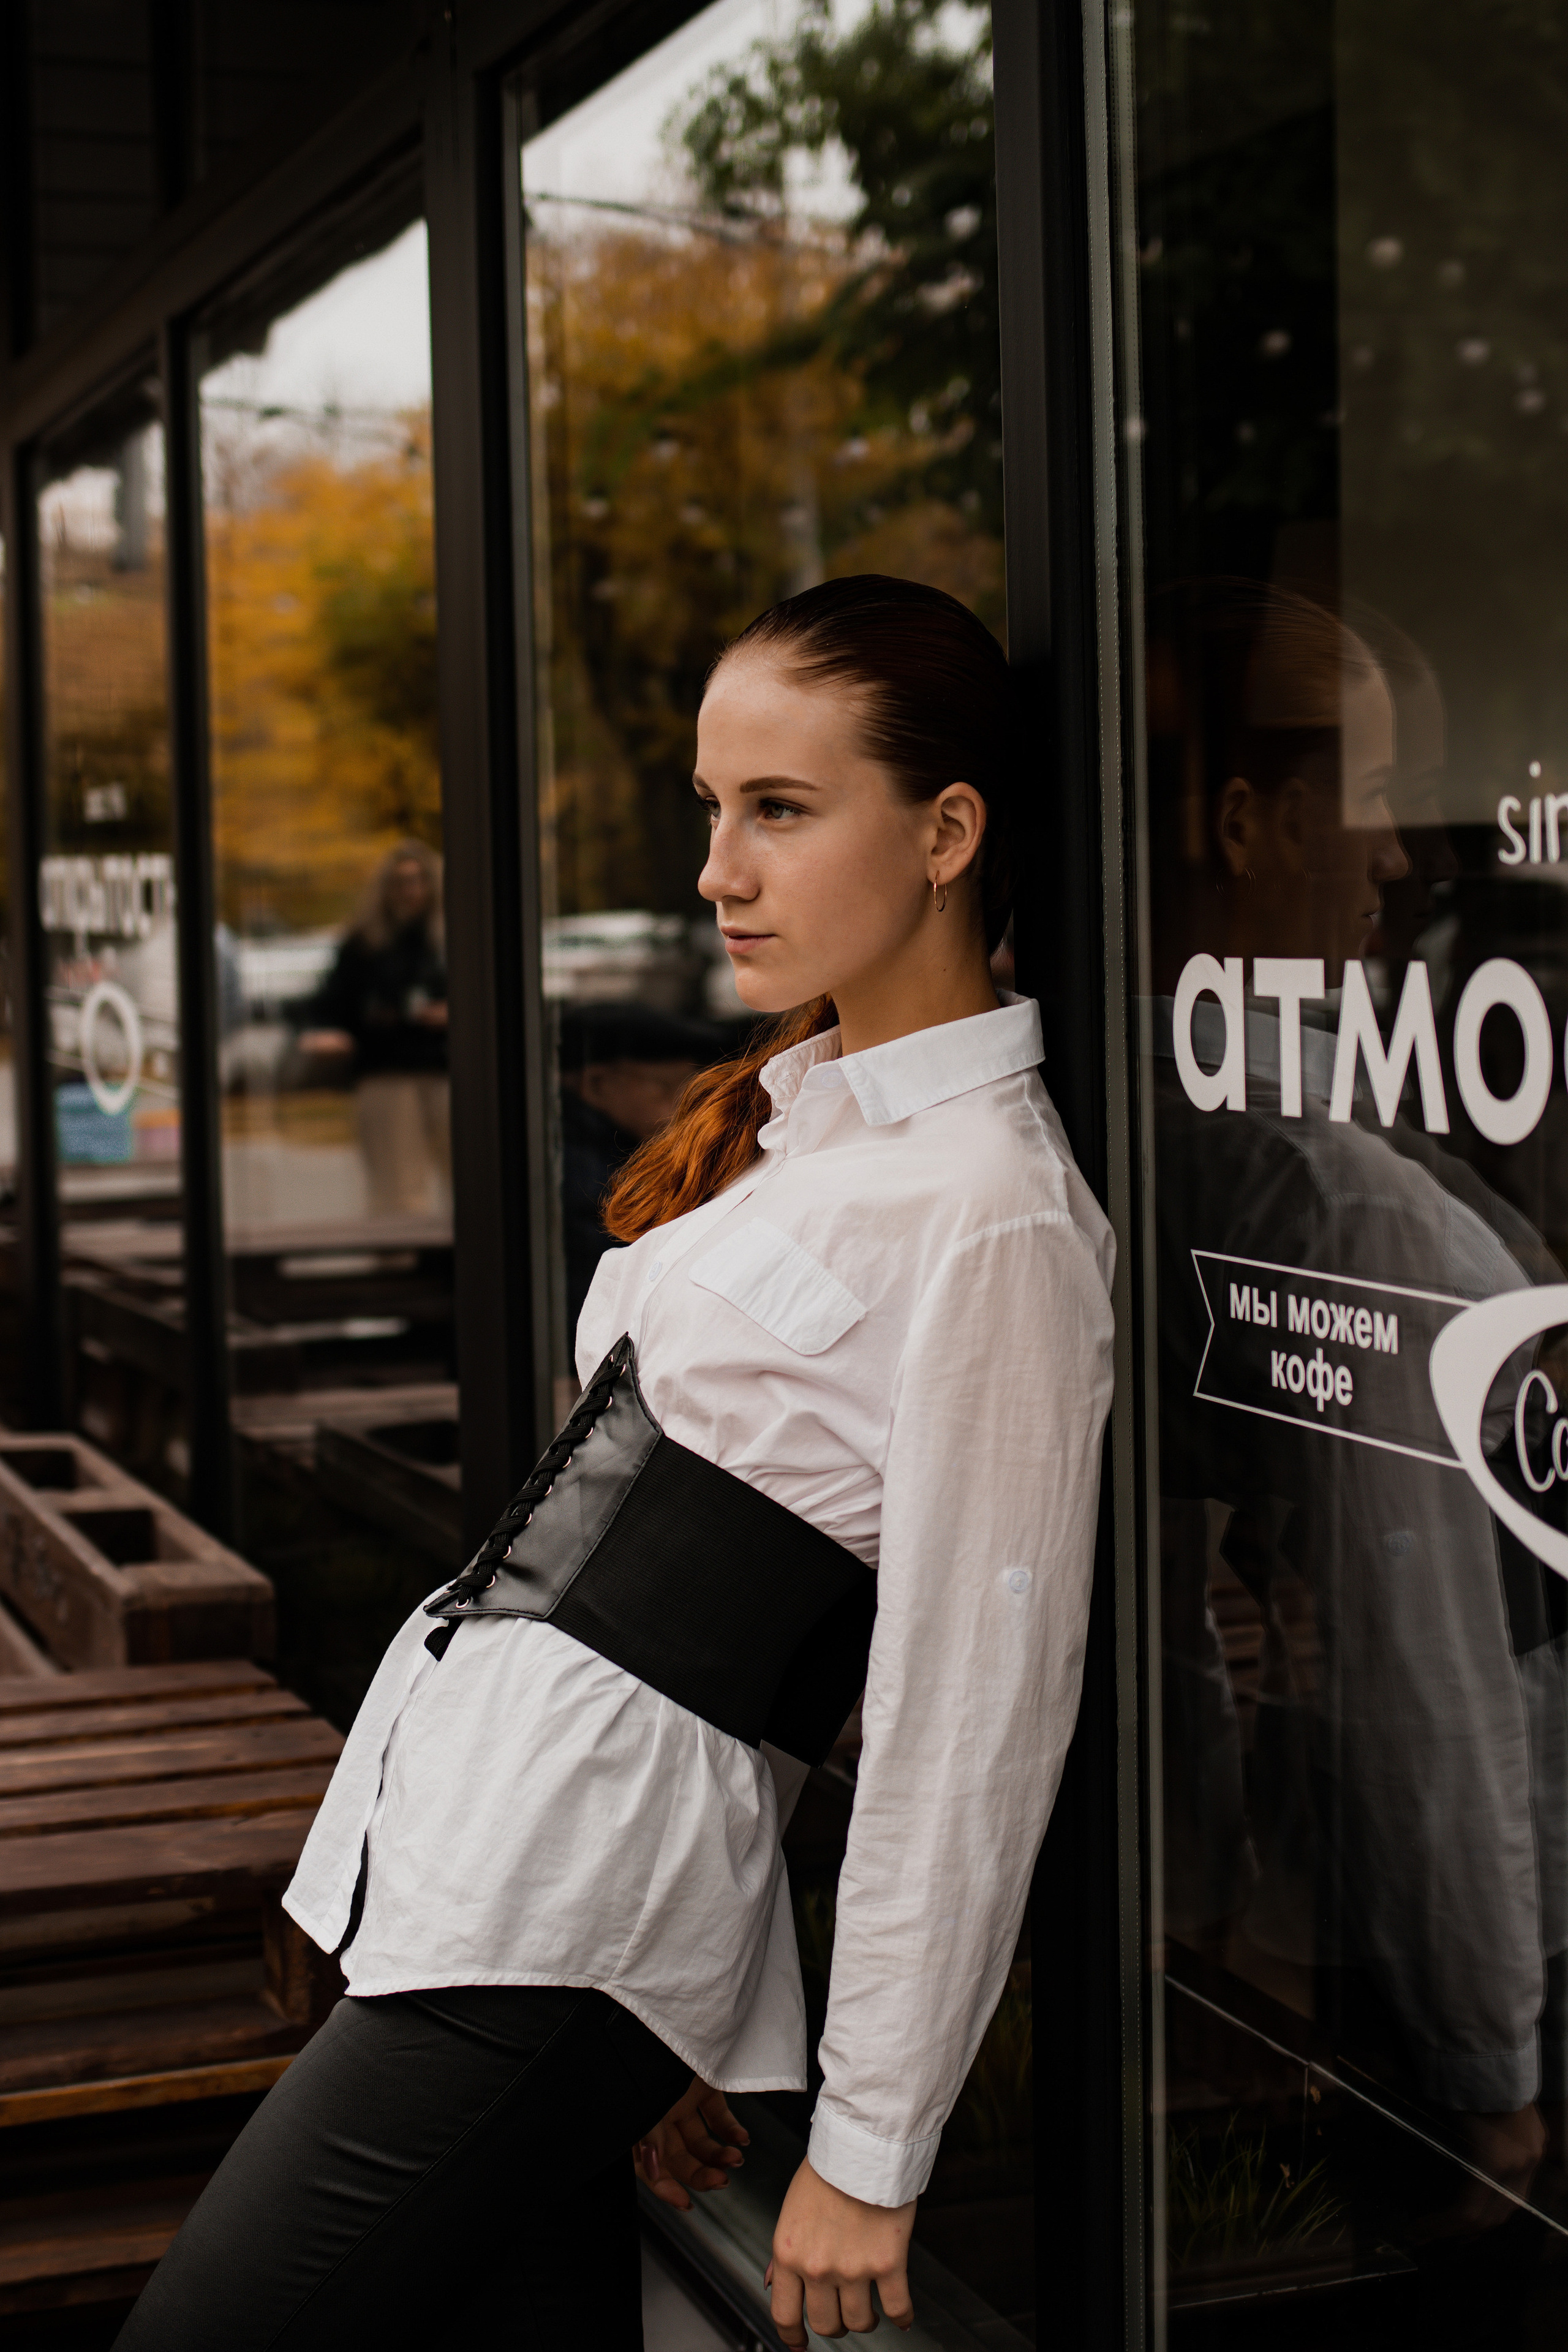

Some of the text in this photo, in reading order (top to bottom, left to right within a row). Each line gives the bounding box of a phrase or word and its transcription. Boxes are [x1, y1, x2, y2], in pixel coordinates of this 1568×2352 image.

[1172, 953, 1568, 1145] атмо
[1230, 1283, 1399, 1355] мы можем
[1270, 1348, 1354, 1412] кофе
